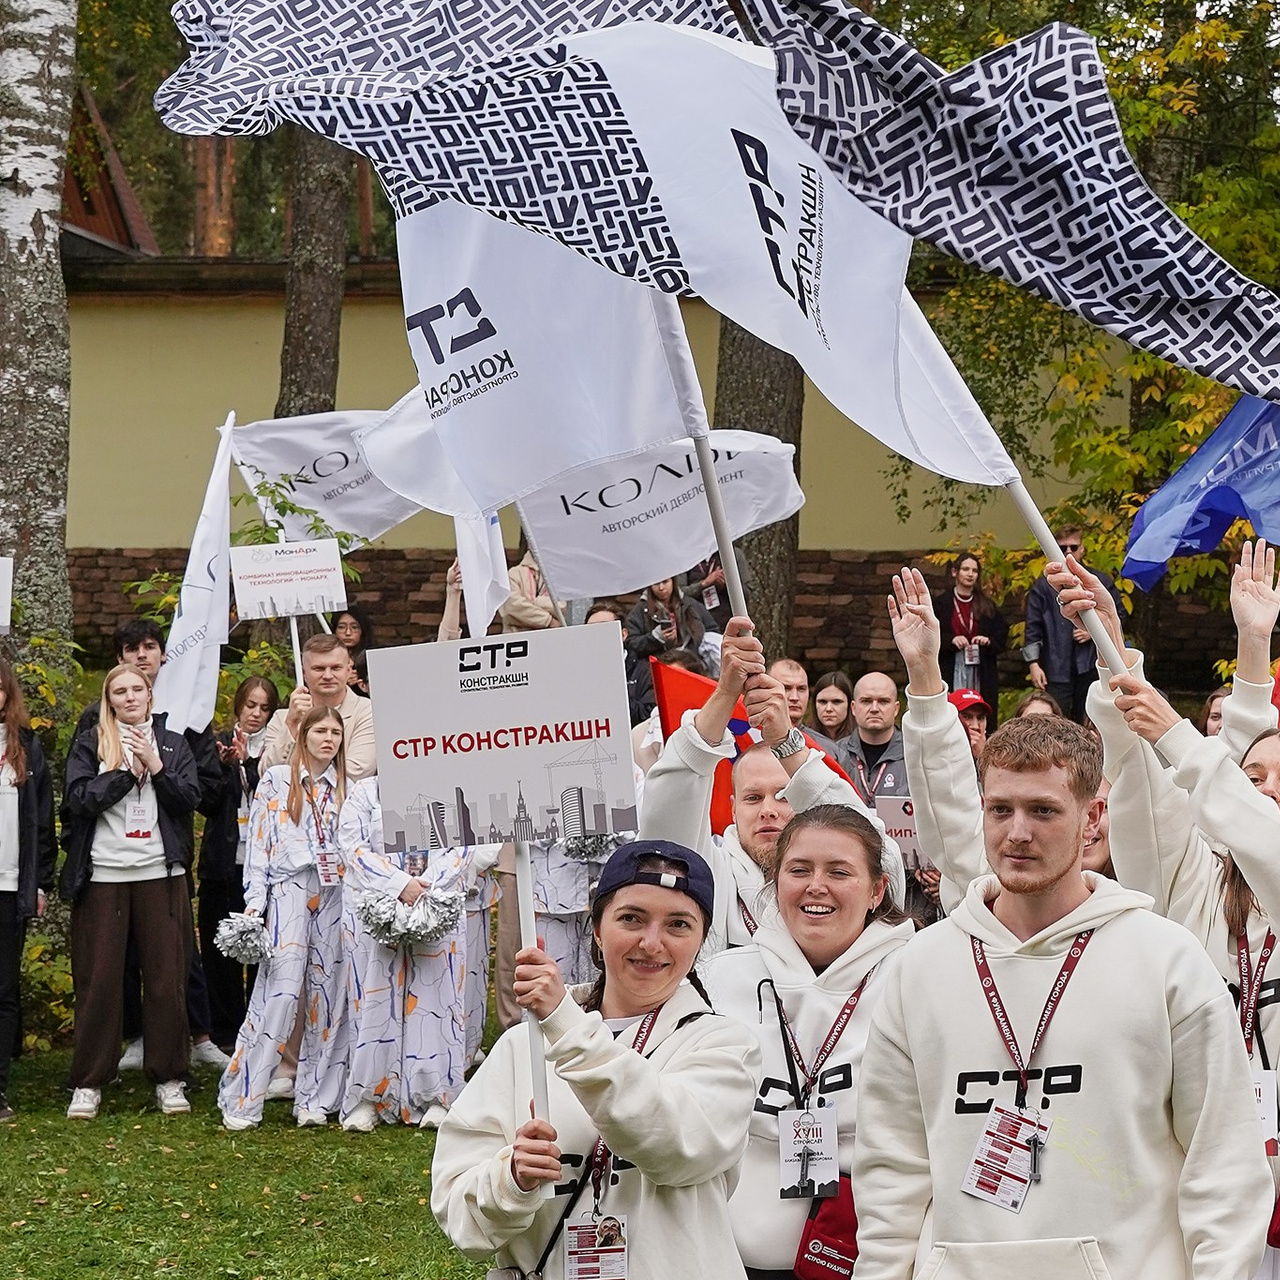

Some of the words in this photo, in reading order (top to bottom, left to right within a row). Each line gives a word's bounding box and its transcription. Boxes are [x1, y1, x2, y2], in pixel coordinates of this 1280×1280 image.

[601, 501, 670, 534] АВТОРСКИЙ
[239, 572, 274, 580] КОМБИНАТ
[276, 567, 336, 577] ИННОВАЦИОННЫХ
[459, 640, 528, 673] СТР
[460, 672, 529, 688] КОНСТРАКШН
[392, 737, 436, 760] СТР
[442, 718, 611, 755] КОНСТРАКШН
[1050, 970, 1069, 1002] ГОРОДА
[825, 1013, 848, 1052] ФУНДАМЕНТ
[992, 996, 1013, 1041] ФУНДАМЕНТ
[1244, 1008, 1254, 1039] ГОРОДА
[793, 1127, 822, 1139] XVIII
